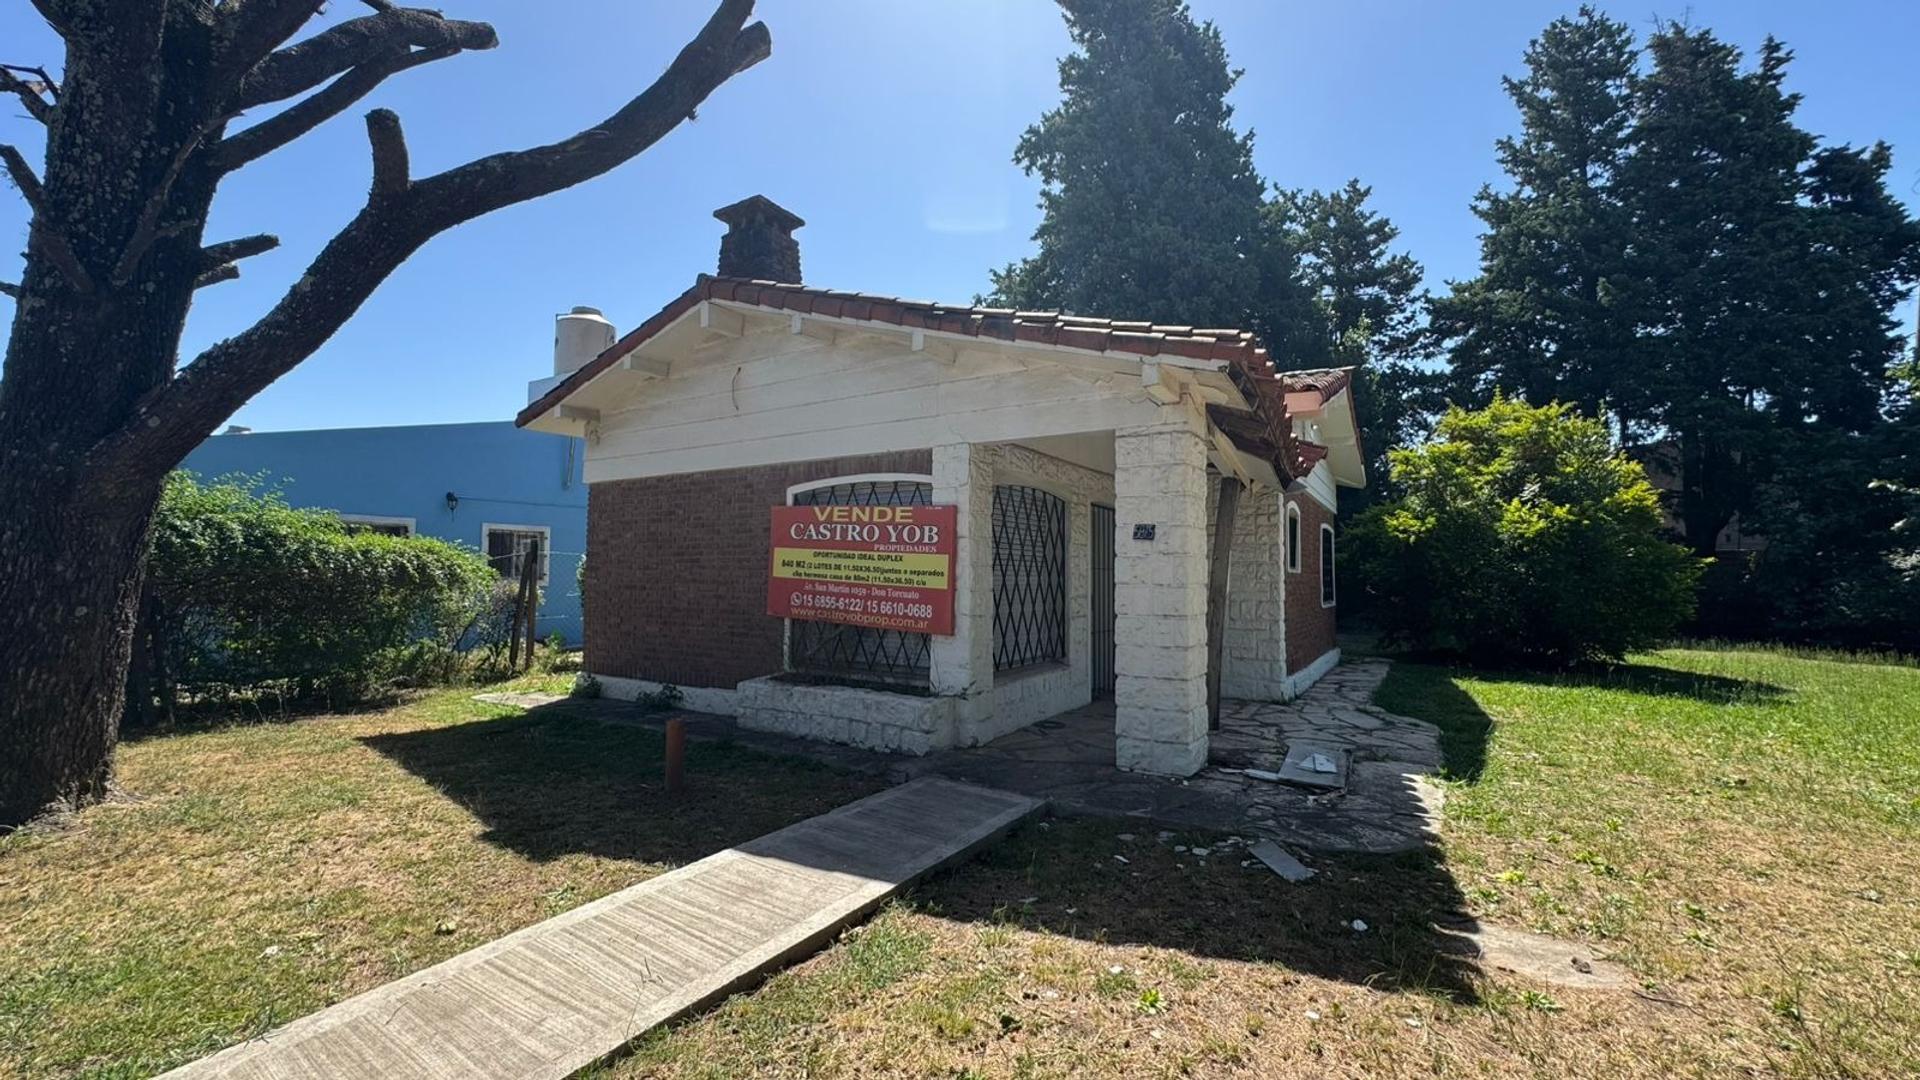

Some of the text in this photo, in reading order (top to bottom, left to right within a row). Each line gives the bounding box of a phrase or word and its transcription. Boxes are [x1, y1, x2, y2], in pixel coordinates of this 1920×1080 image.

[814, 507, 913, 522] VENDE
[790, 523, 939, 543] CASTRO YOB
[874, 544, 937, 552] PROPIEDADES
[813, 551, 903, 562] OPORTUNIDAD IDEAL DUPLEX
[814, 562, 832, 570] LOTES
[909, 568, 945, 577] separados
[814, 582, 827, 592] San
[871, 587, 886, 597] Don
[887, 588, 919, 599] Torcuato
[803, 594, 813, 607] 15
[867, 599, 878, 613] 15
[880, 601, 933, 618] 6610-0688
[790, 607, 929, 629] www.castroyobprop.com.ar
